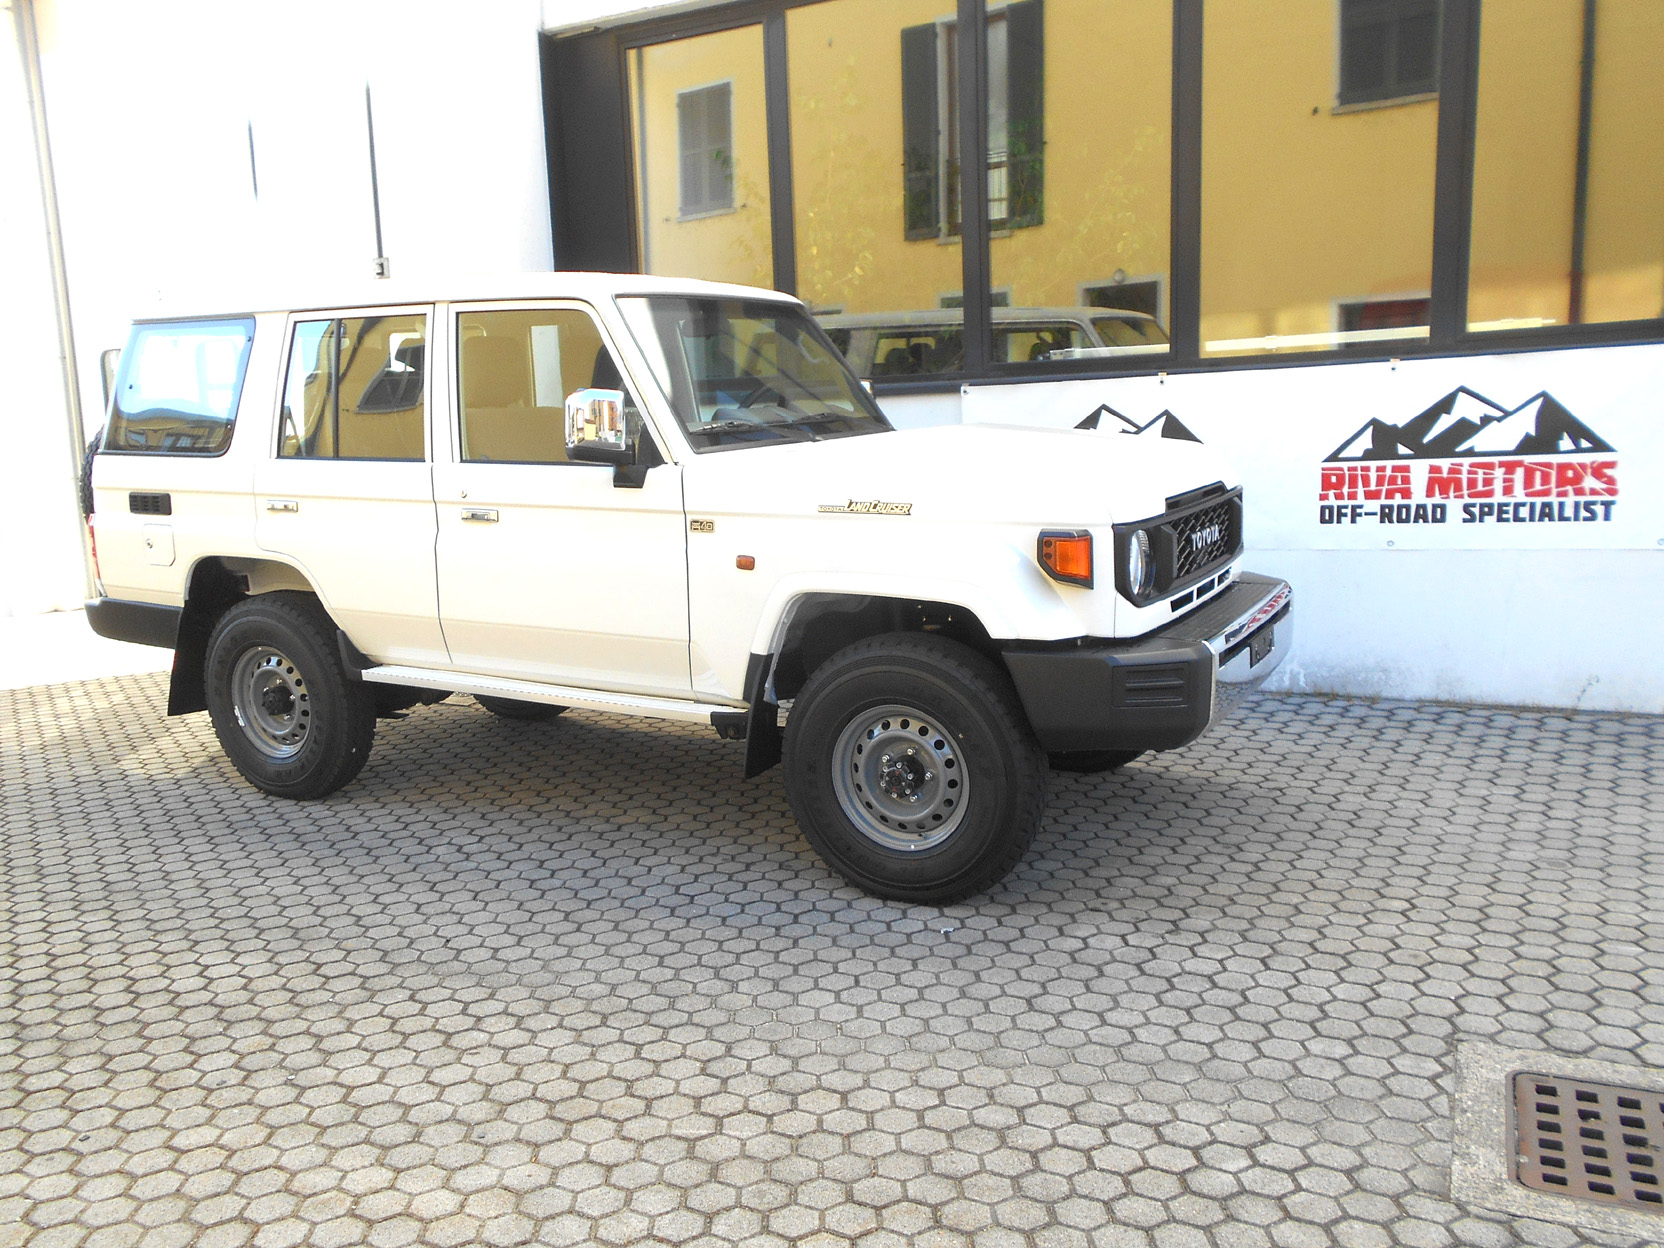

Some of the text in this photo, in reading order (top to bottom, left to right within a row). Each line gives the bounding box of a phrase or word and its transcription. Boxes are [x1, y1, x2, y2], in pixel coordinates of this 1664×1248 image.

[1319, 464, 1412, 501] RIVA
[1319, 500, 1617, 524] OFF-ROAD SPECIALIST
[1191, 524, 1220, 551] TOYOTA
